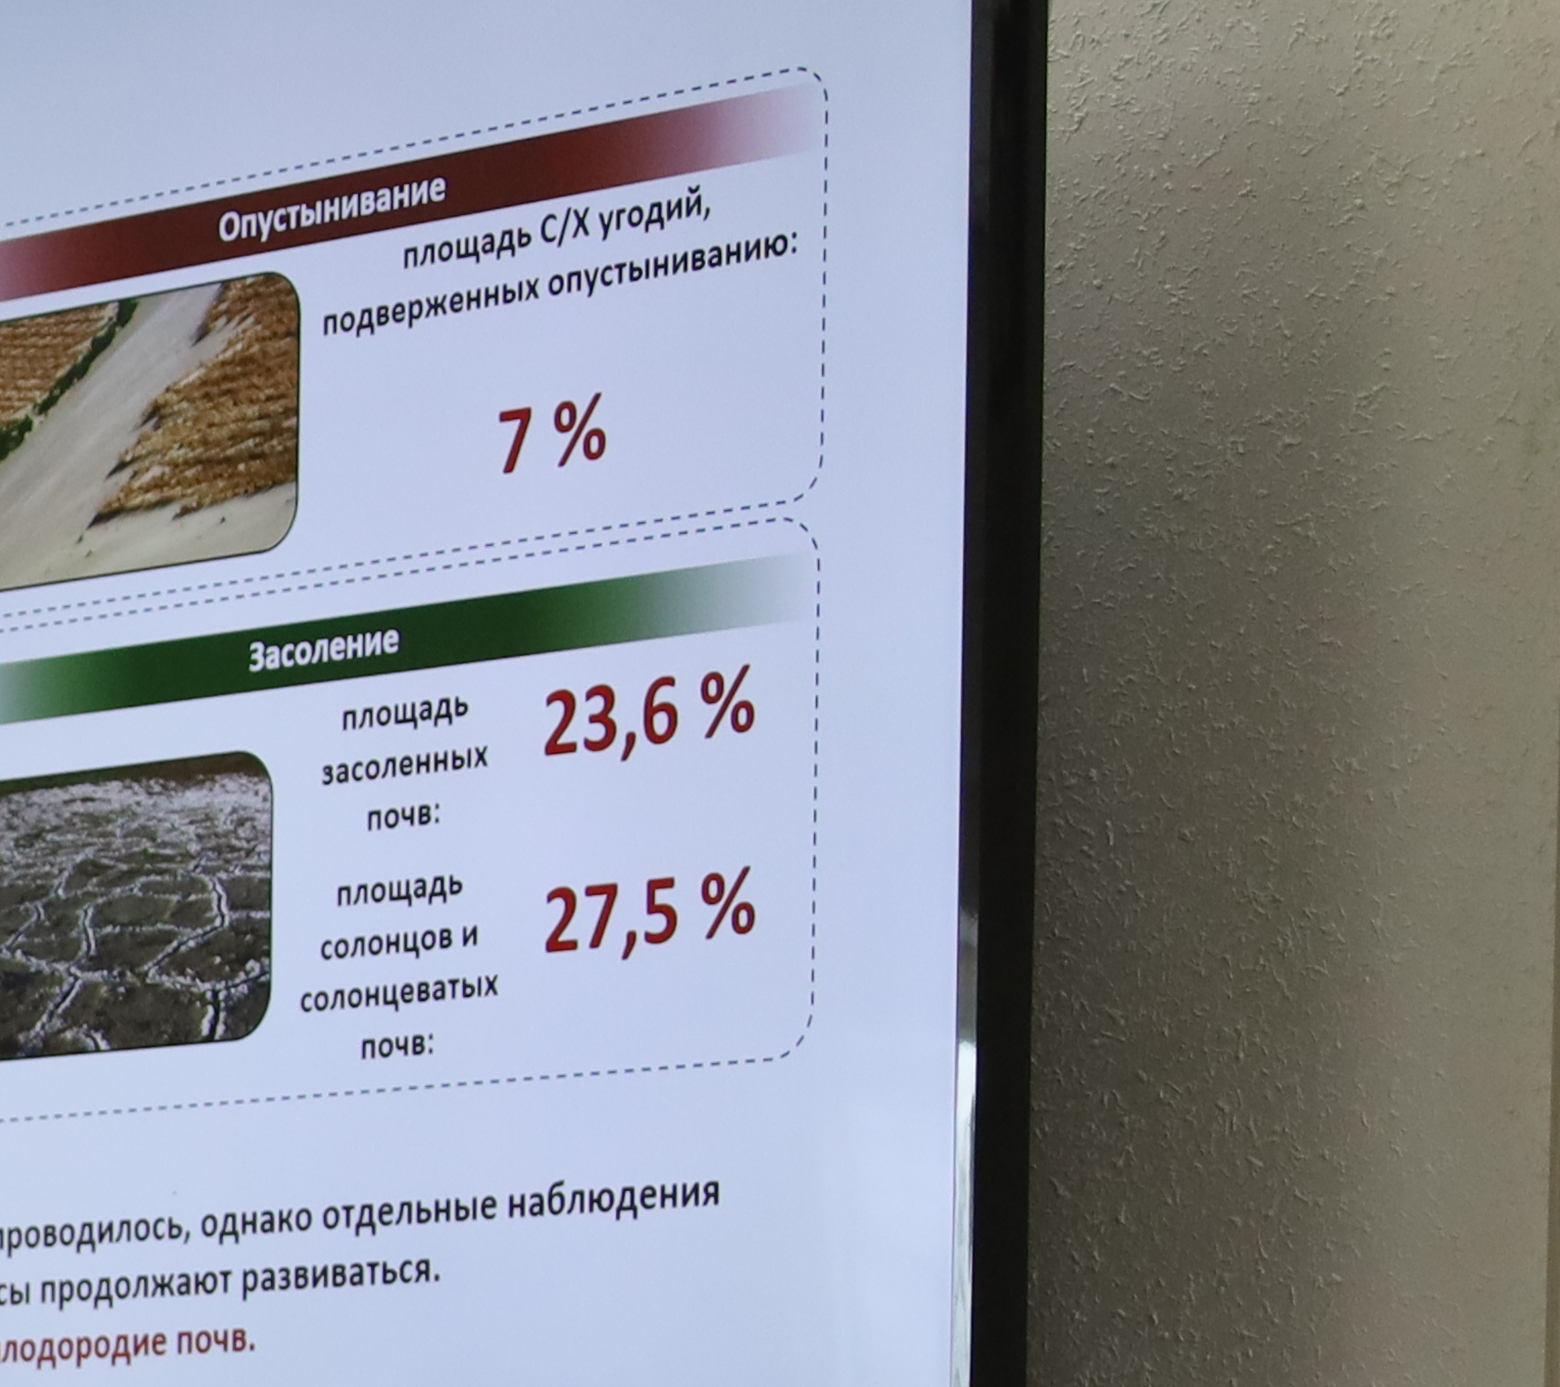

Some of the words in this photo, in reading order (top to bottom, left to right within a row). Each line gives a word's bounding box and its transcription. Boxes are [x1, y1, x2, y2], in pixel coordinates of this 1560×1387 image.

[219, 178, 445, 242] Опустынивание
[404, 228, 532, 268] площадь
[599, 185, 710, 241] угодий,
[324, 278, 539, 337] подверженных
[548, 232, 797, 297] опустыниванию:
[499, 407, 531, 474] 7
[554, 393, 606, 467] %
[249, 630, 399, 672] Засоление
[343, 697, 468, 730] площадь
[545, 676, 678, 758] 23,6
[701, 665, 754, 738] %
[323, 746, 487, 785] засоленных
[368, 804, 439, 831] почв:
[338, 875, 463, 907] площадь
[545, 877, 677, 960] 27,5
[701, 866, 755, 939] %
[321, 928, 452, 960] солонцов
[463, 926, 477, 947] и
[301, 975, 498, 1013] солонцеватых
[362, 1034, 433, 1059] почв:
[201, 1208, 312, 1245] однако
[323, 1196, 497, 1237] отдельные
[509, 1180, 719, 1221] наблюдения
[41, 1270, 232, 1311] продолжают
[242, 1259, 440, 1301] развиваться.
[177, 1329, 254, 1354] почв.
